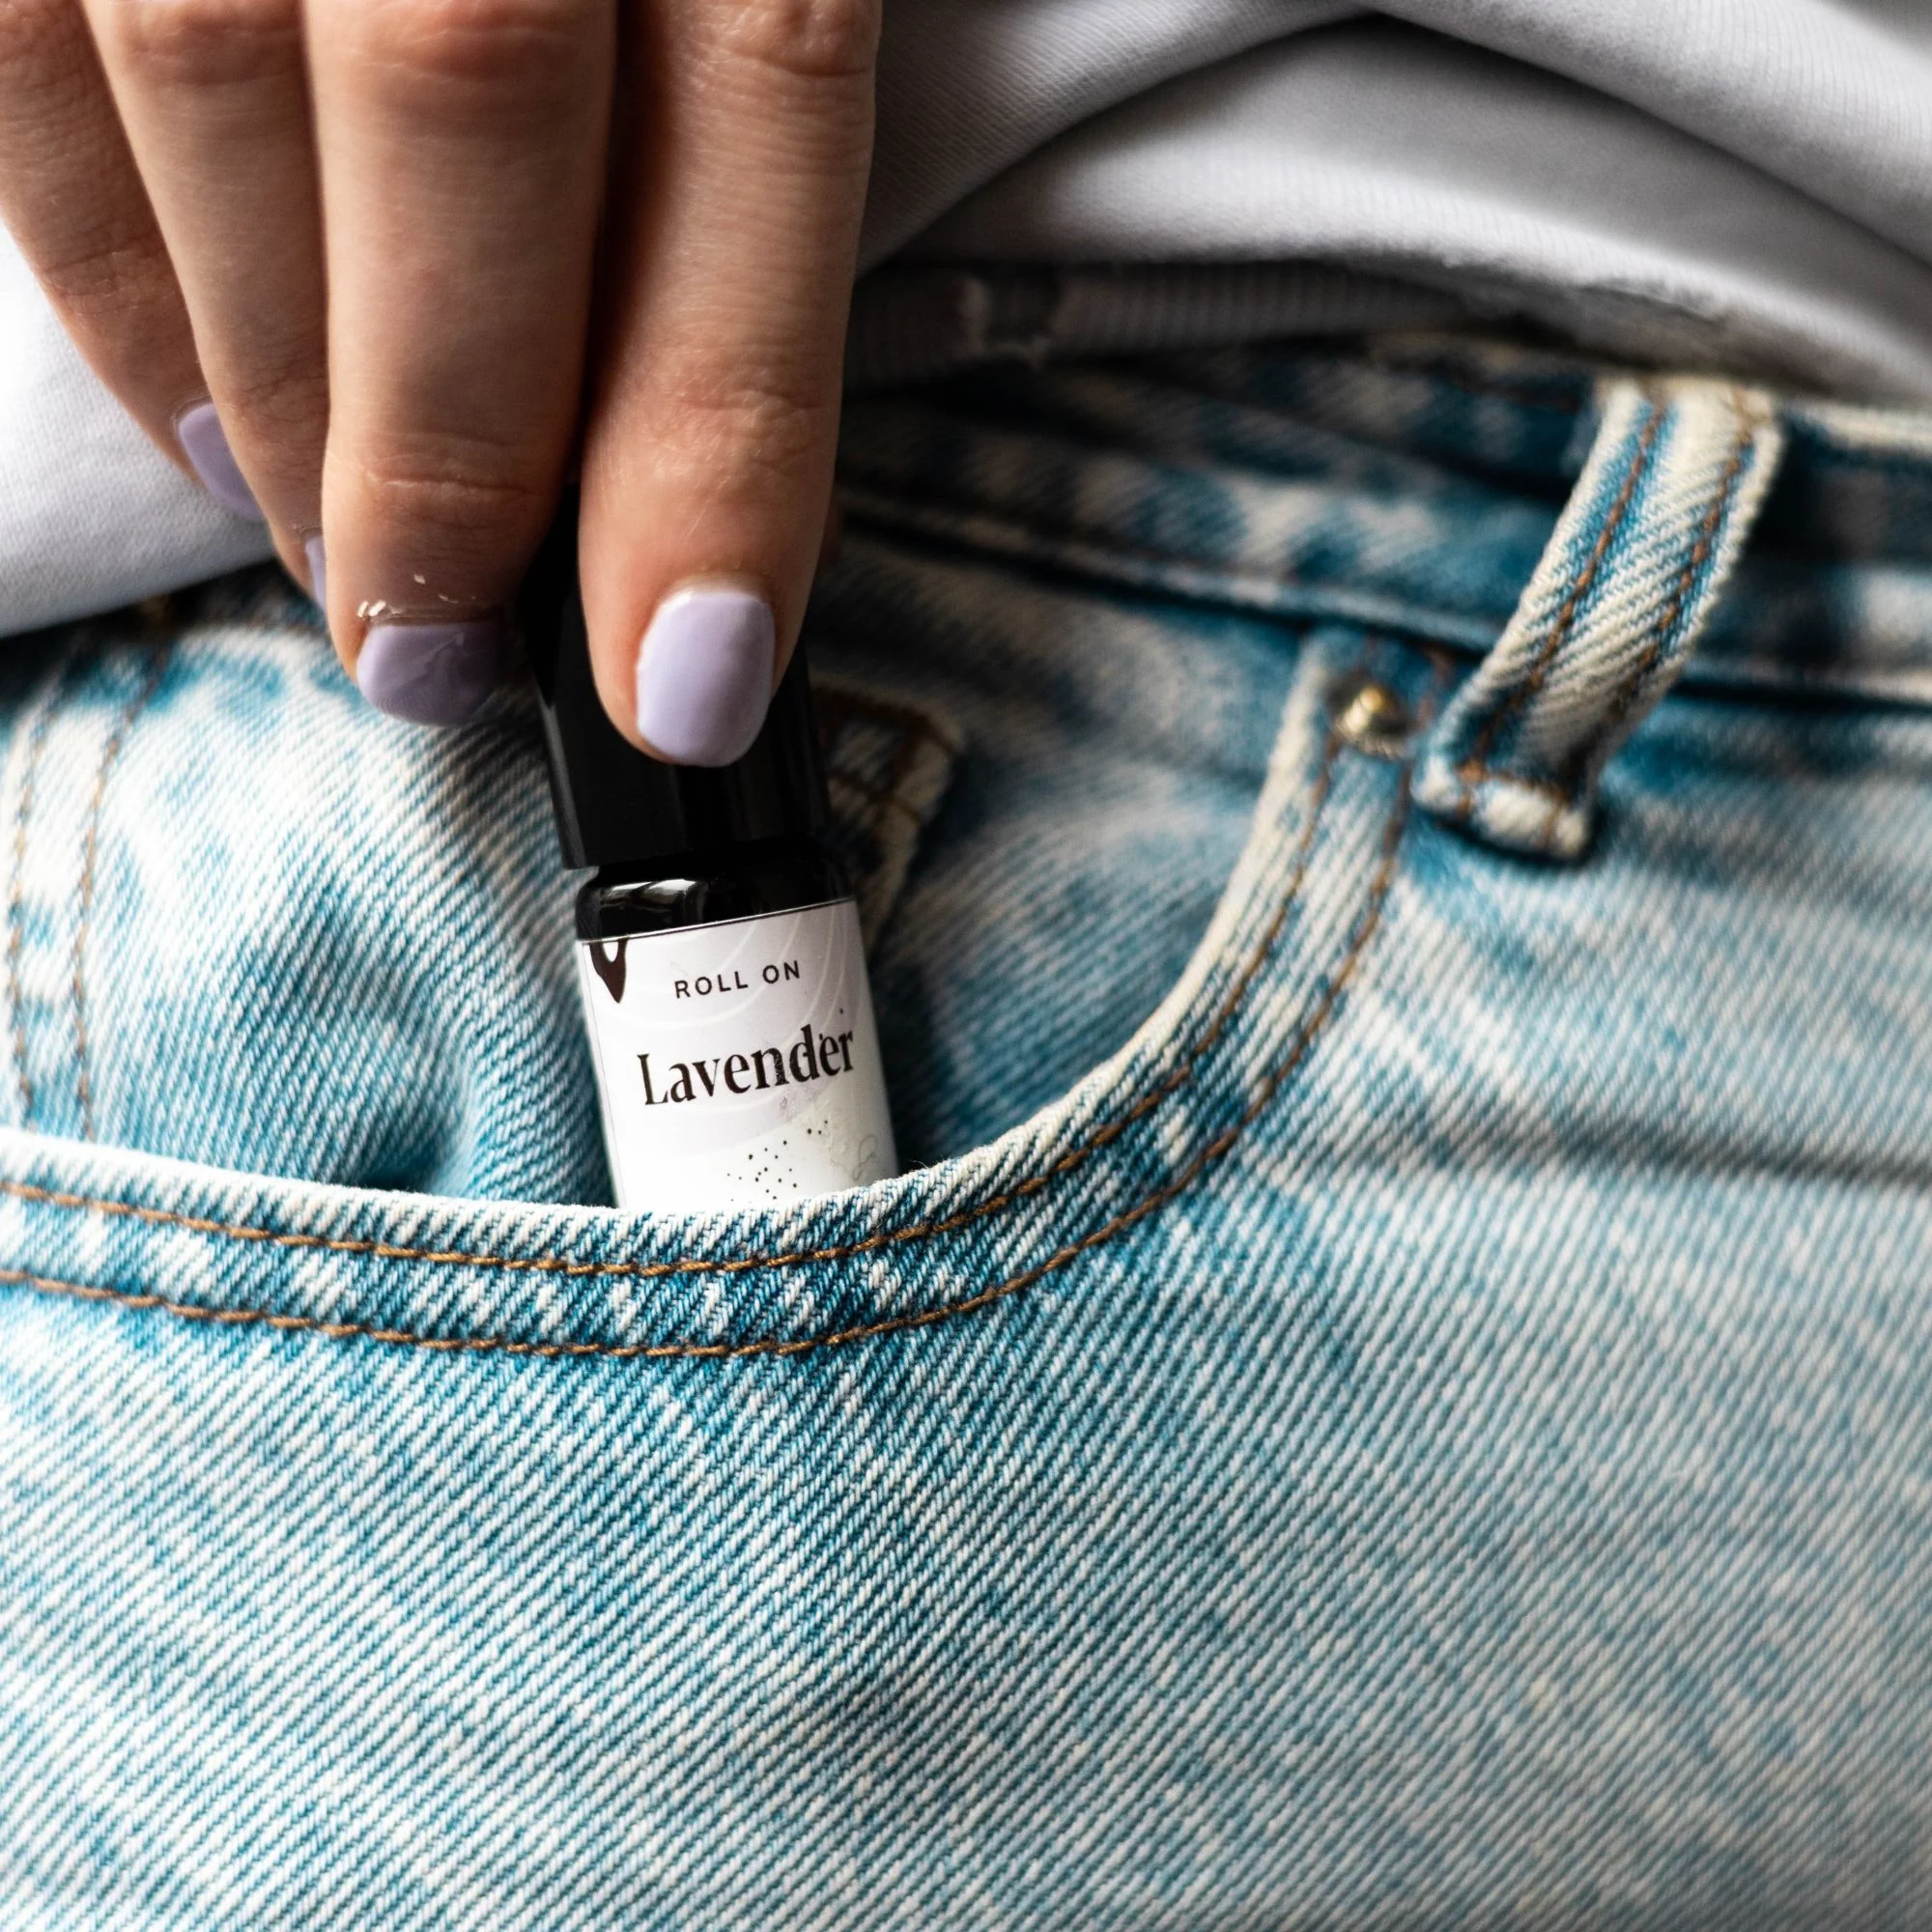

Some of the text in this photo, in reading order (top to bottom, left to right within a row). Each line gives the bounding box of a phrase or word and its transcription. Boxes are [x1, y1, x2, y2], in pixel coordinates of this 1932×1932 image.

[674, 960, 801, 999] ROLL ON
[637, 1024, 854, 1106] Lavender
